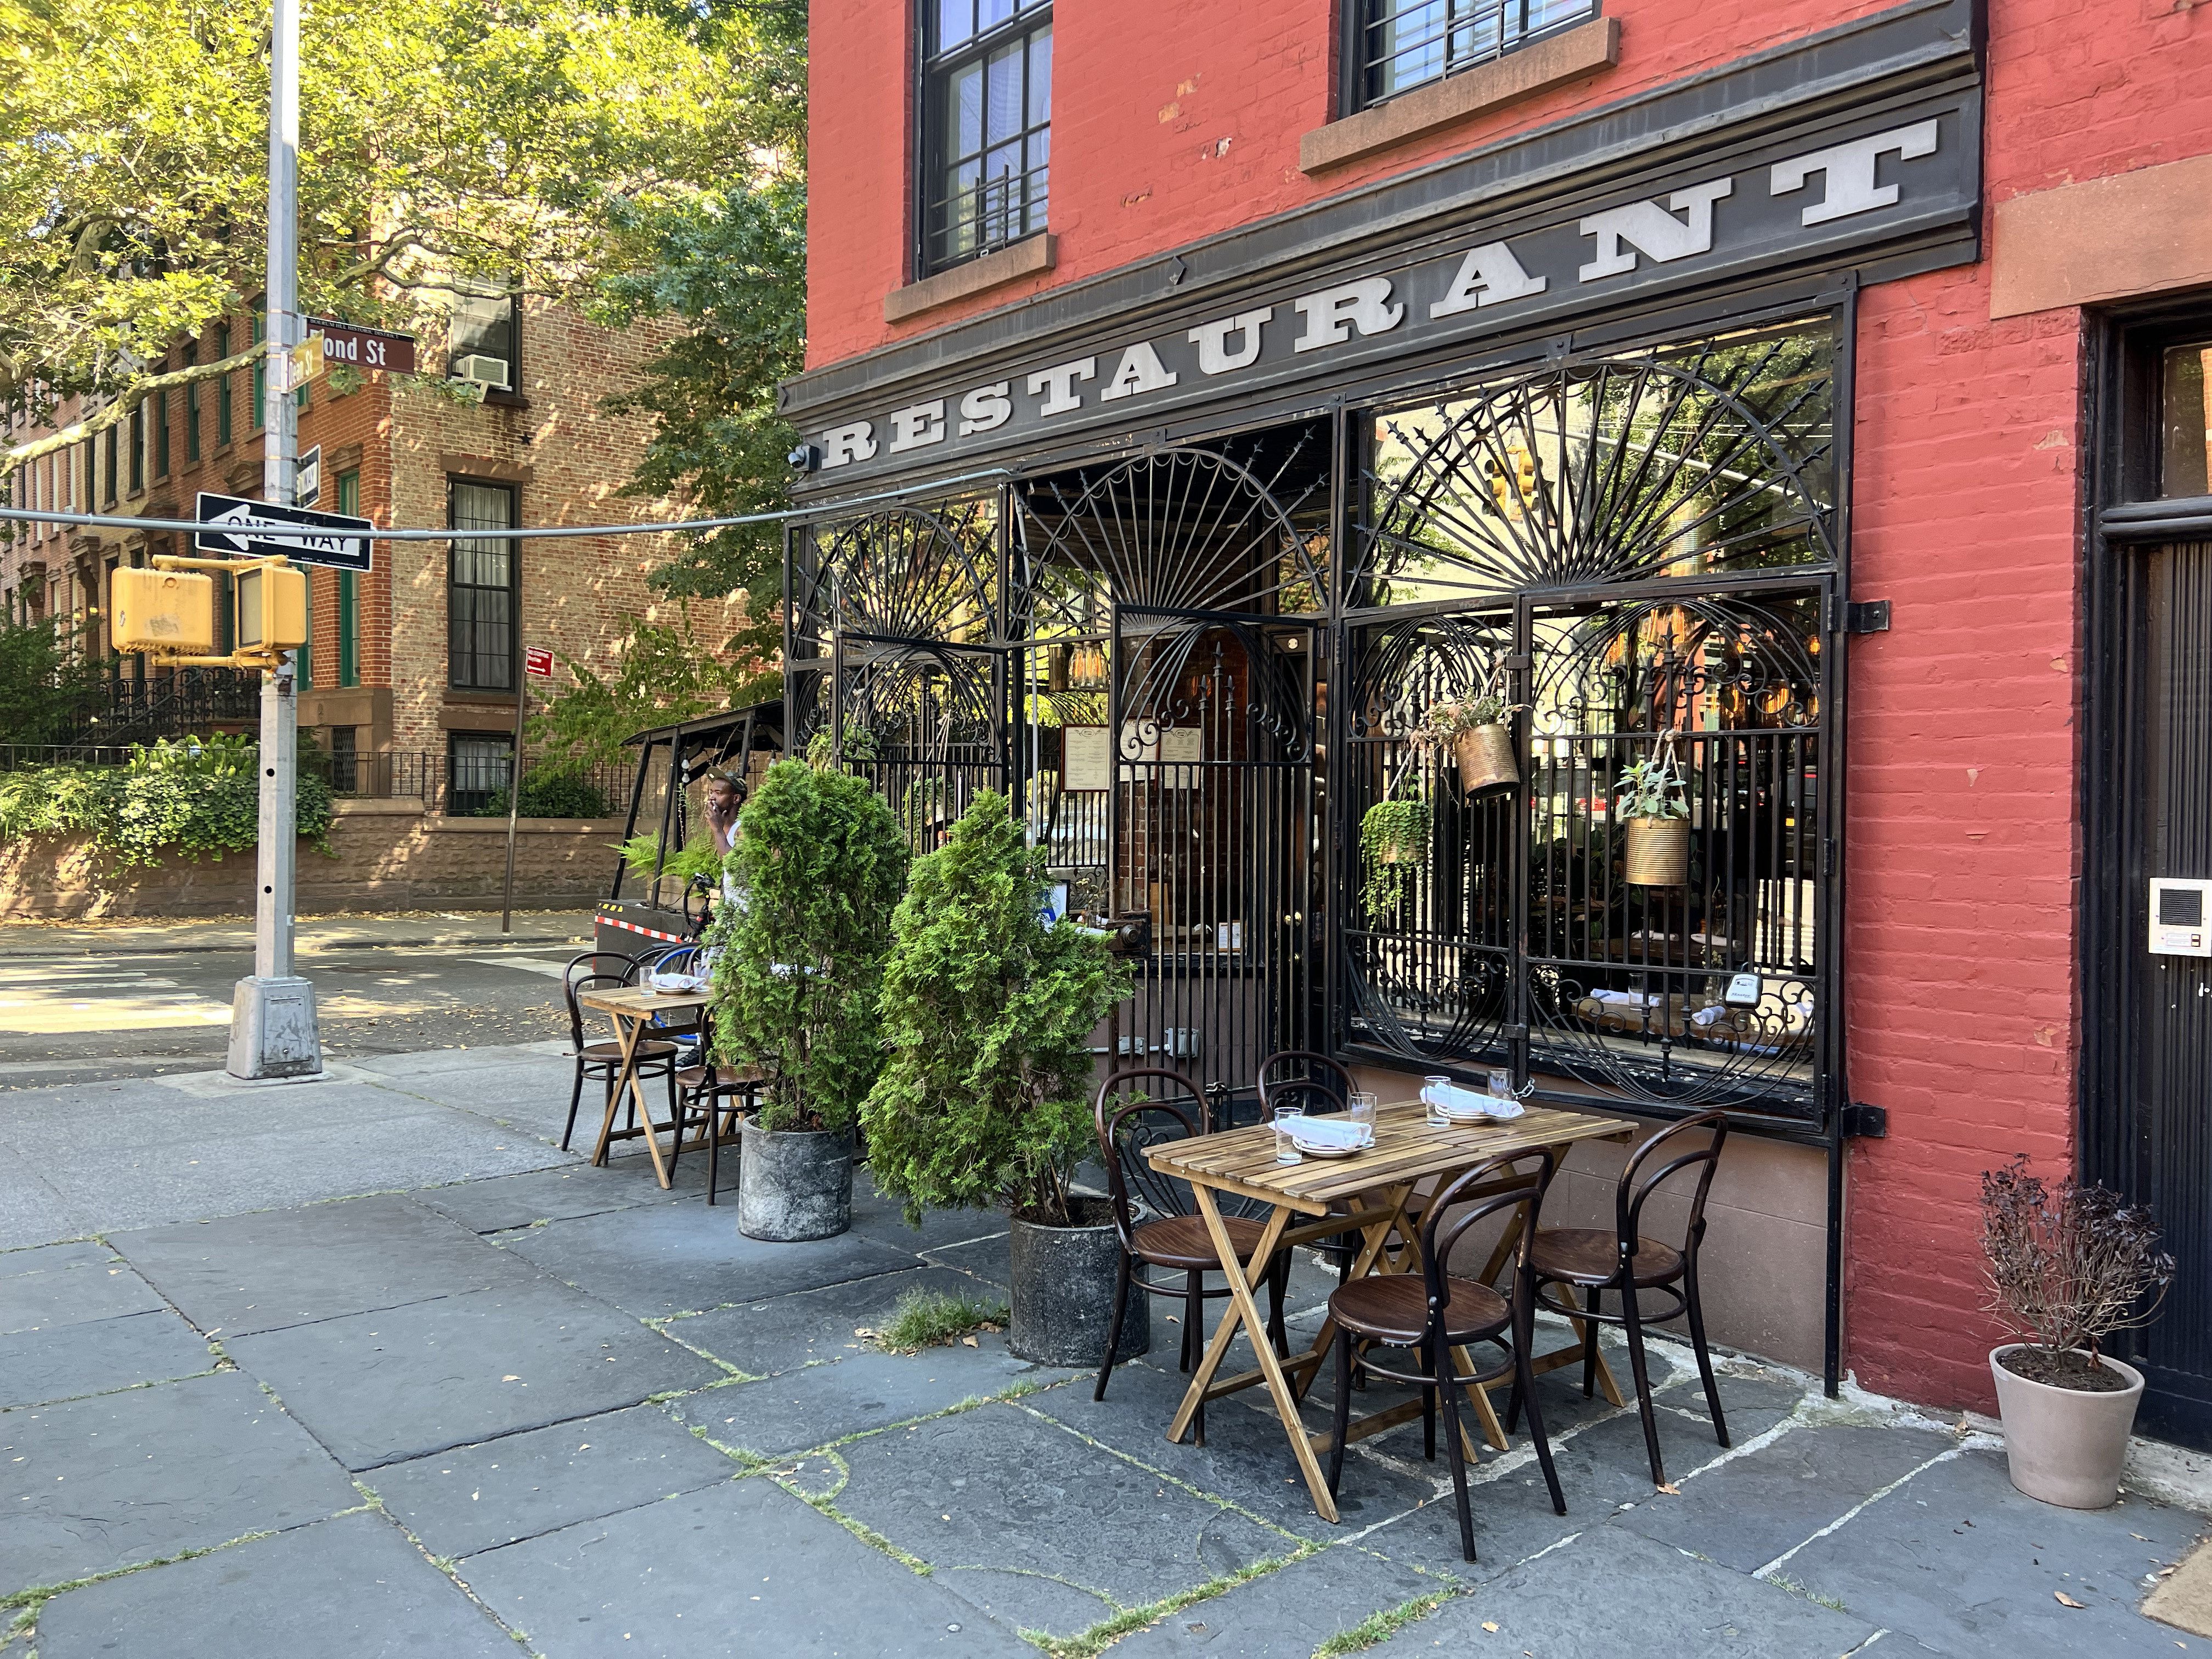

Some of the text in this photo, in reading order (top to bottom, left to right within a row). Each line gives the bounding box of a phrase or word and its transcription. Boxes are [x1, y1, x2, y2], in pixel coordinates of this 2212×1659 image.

[821, 119, 1938, 469] RESTAURANT
[348, 325, 373, 335] HISTORIC
[374, 330, 399, 339] DISTRICT
[311, 329, 386, 366] ond St
[306, 349, 313, 376] St
[301, 526, 347, 551] WAY
